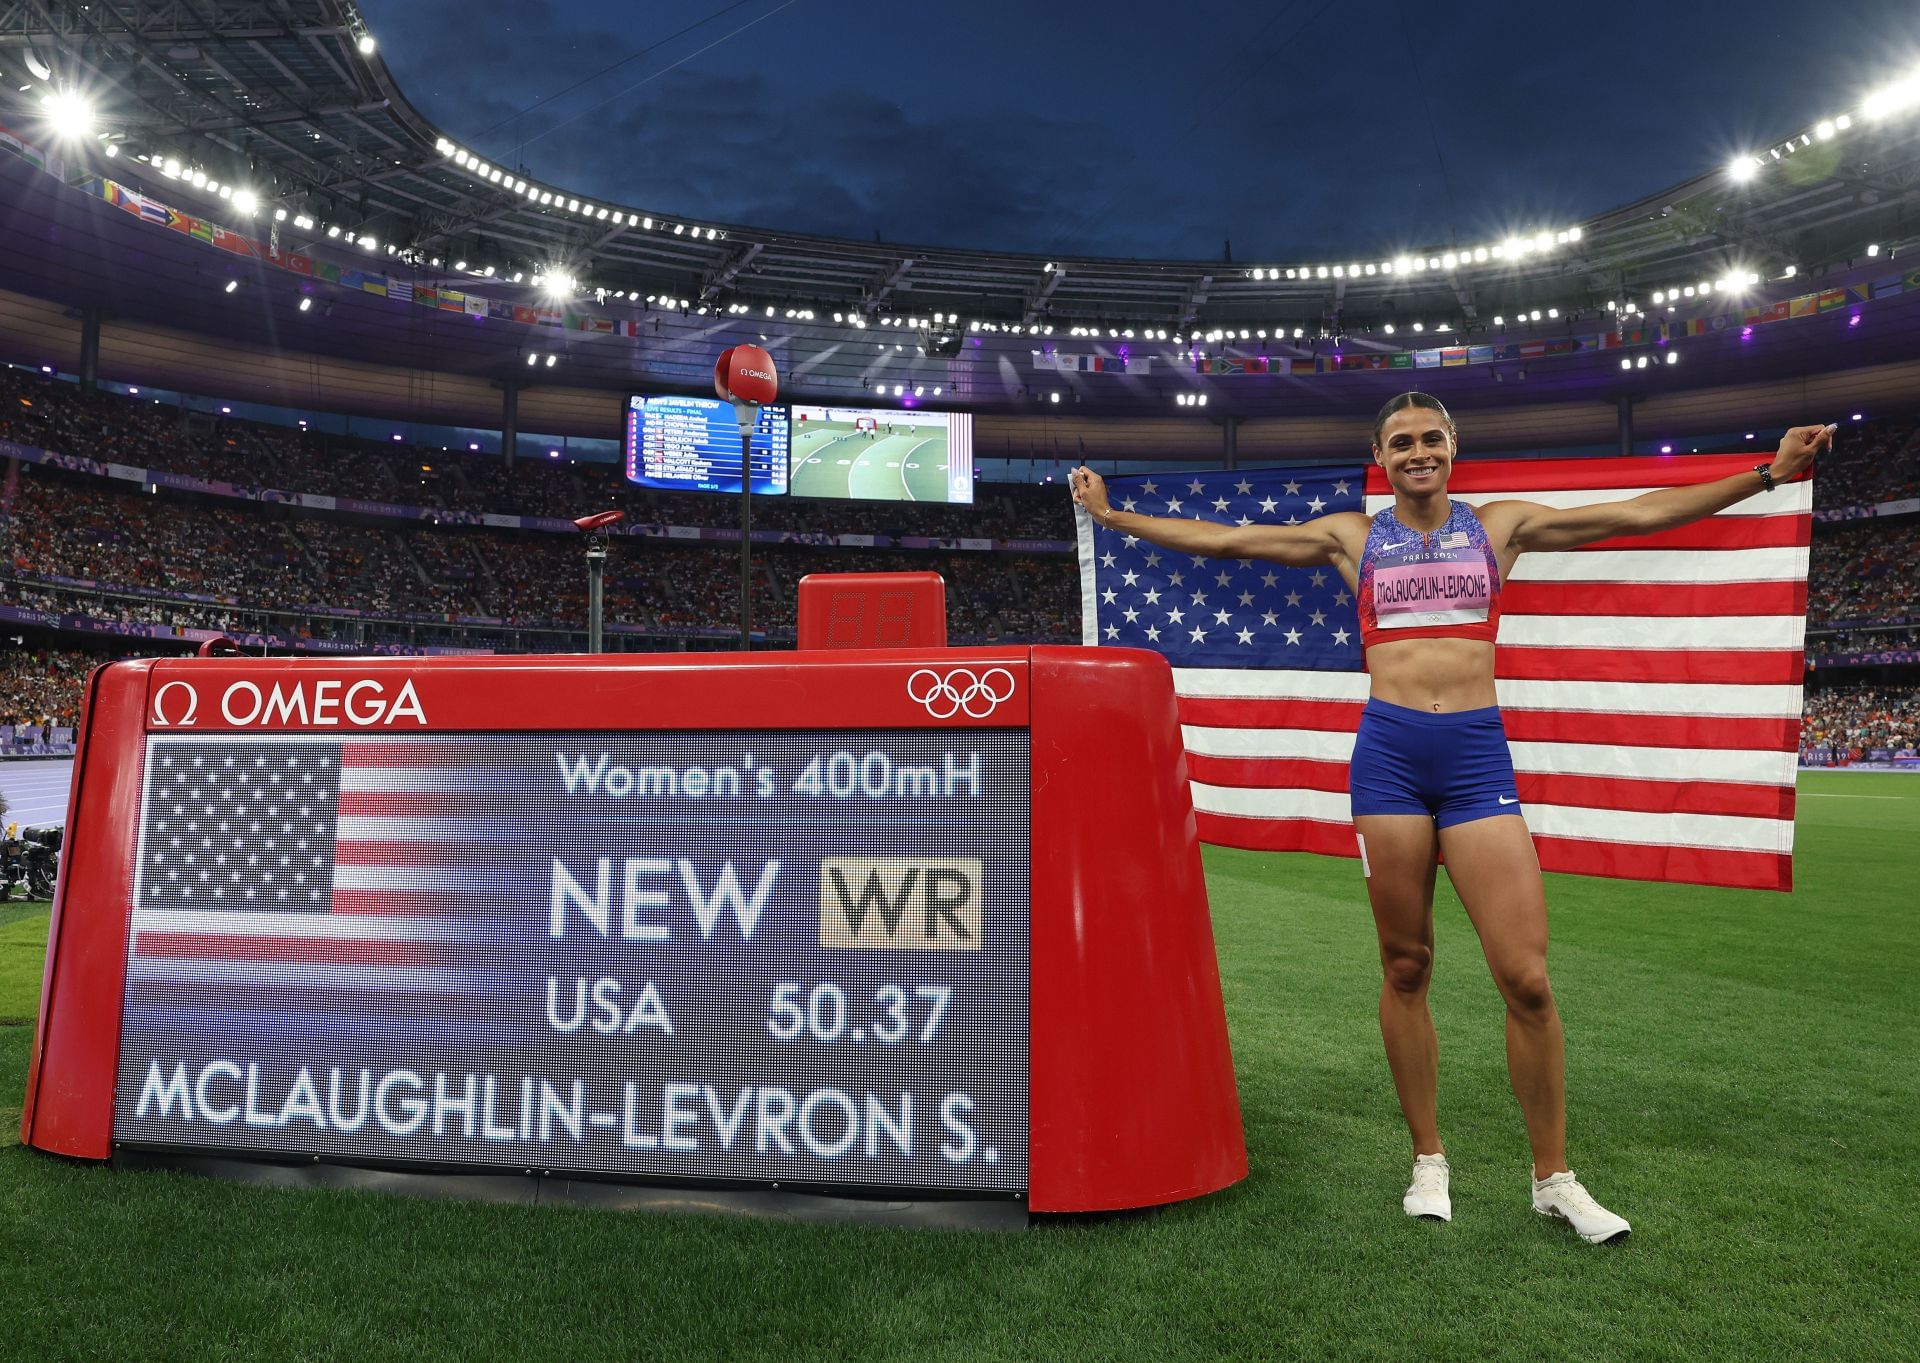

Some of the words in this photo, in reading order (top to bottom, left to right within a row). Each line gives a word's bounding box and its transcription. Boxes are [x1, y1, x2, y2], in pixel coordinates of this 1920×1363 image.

[749, 370, 772, 380] OMEGA
[669, 399, 694, 407] JAVELIN
[695, 400, 720, 408] THROW
[164, 475, 191, 488] PARIS
[352, 502, 377, 512] PARIS
[1403, 553, 1430, 562] PARIS
[18, 611, 37, 619] PARIS
[318, 641, 338, 649] PARIS
[221, 678, 428, 726] OMEGA
[557, 752, 774, 798] Women's
[794, 751, 983, 797] 400mH
[549, 857, 782, 941] NEW
[830, 866, 974, 940] WR
[545, 977, 675, 1035] USA
[768, 983, 955, 1042] 50.37
[135, 1057, 915, 1159] MCLAUGHLIN-LEVRON
[940, 1091, 1002, 1165] S.
